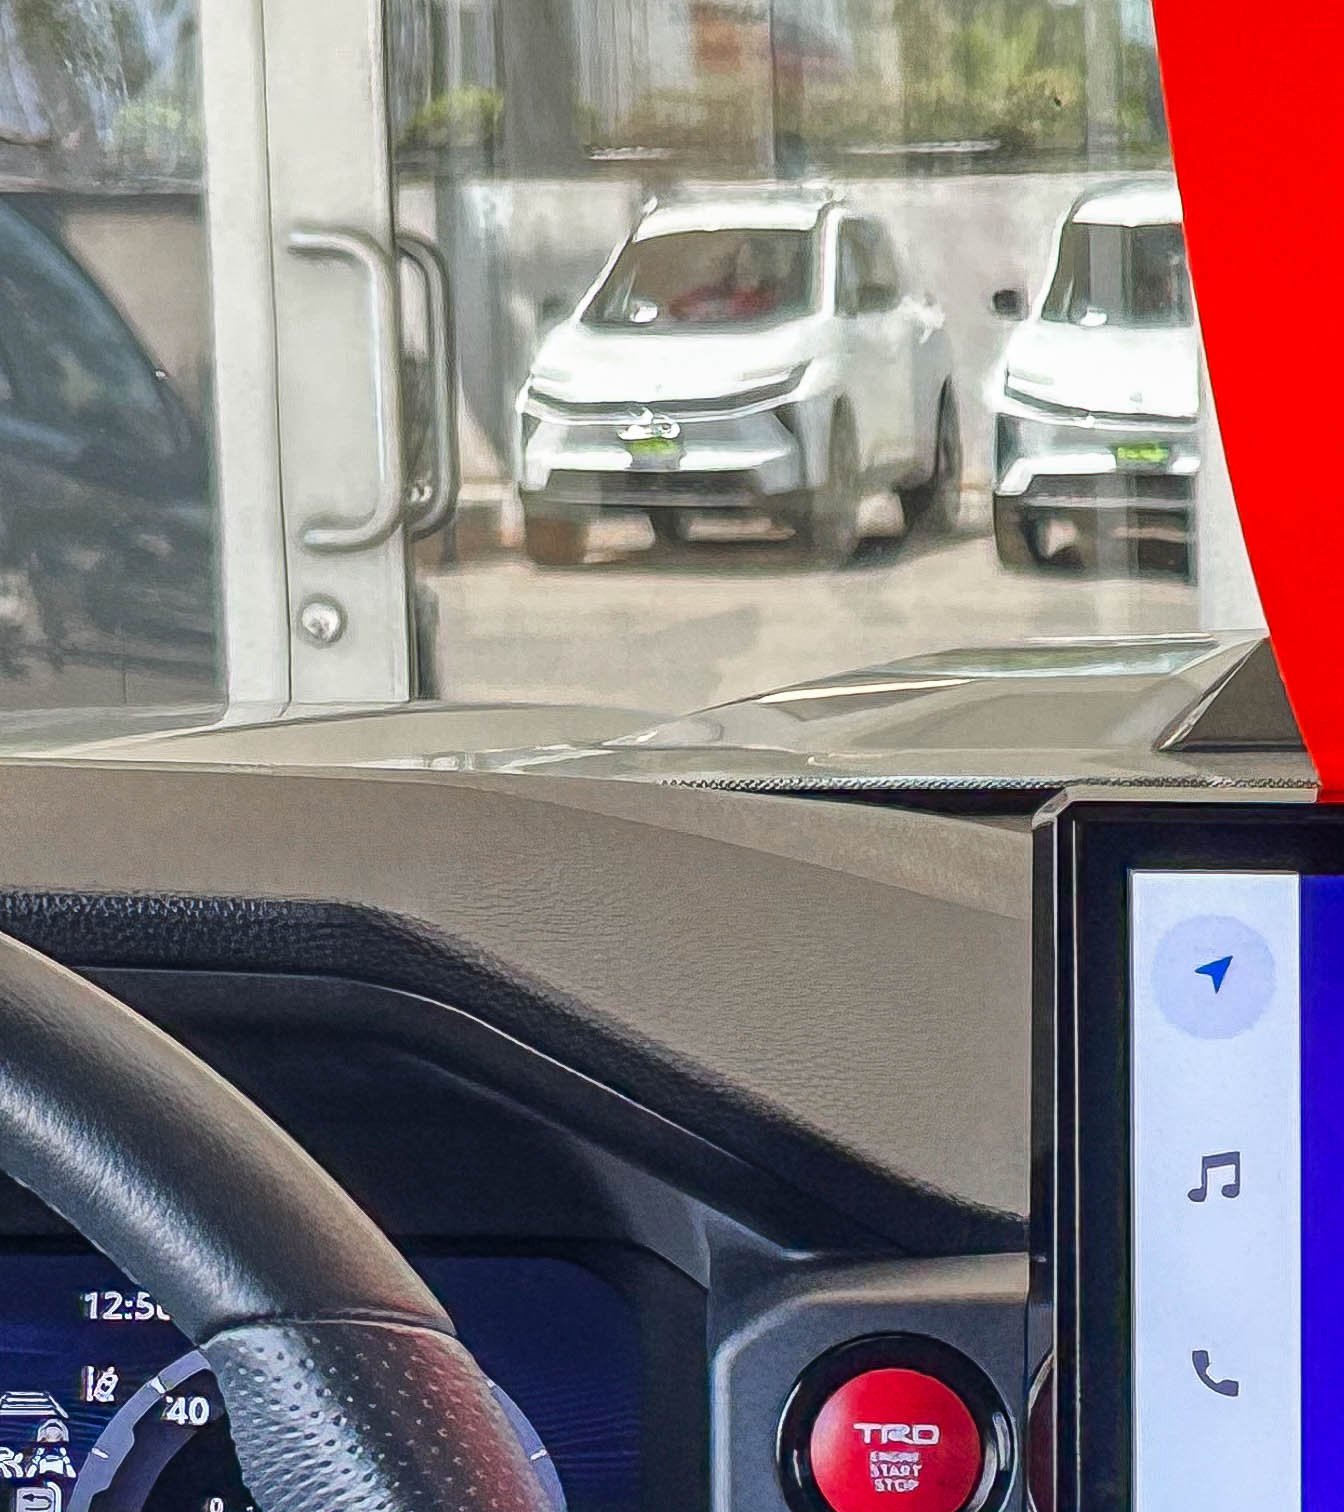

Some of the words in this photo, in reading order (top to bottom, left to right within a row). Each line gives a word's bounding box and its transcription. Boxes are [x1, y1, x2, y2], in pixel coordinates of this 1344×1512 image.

[166, 1396, 210, 1426] 40
[853, 1423, 940, 1445] TRD
[870, 1463, 922, 1477] START
[875, 1478, 919, 1492] STOP
